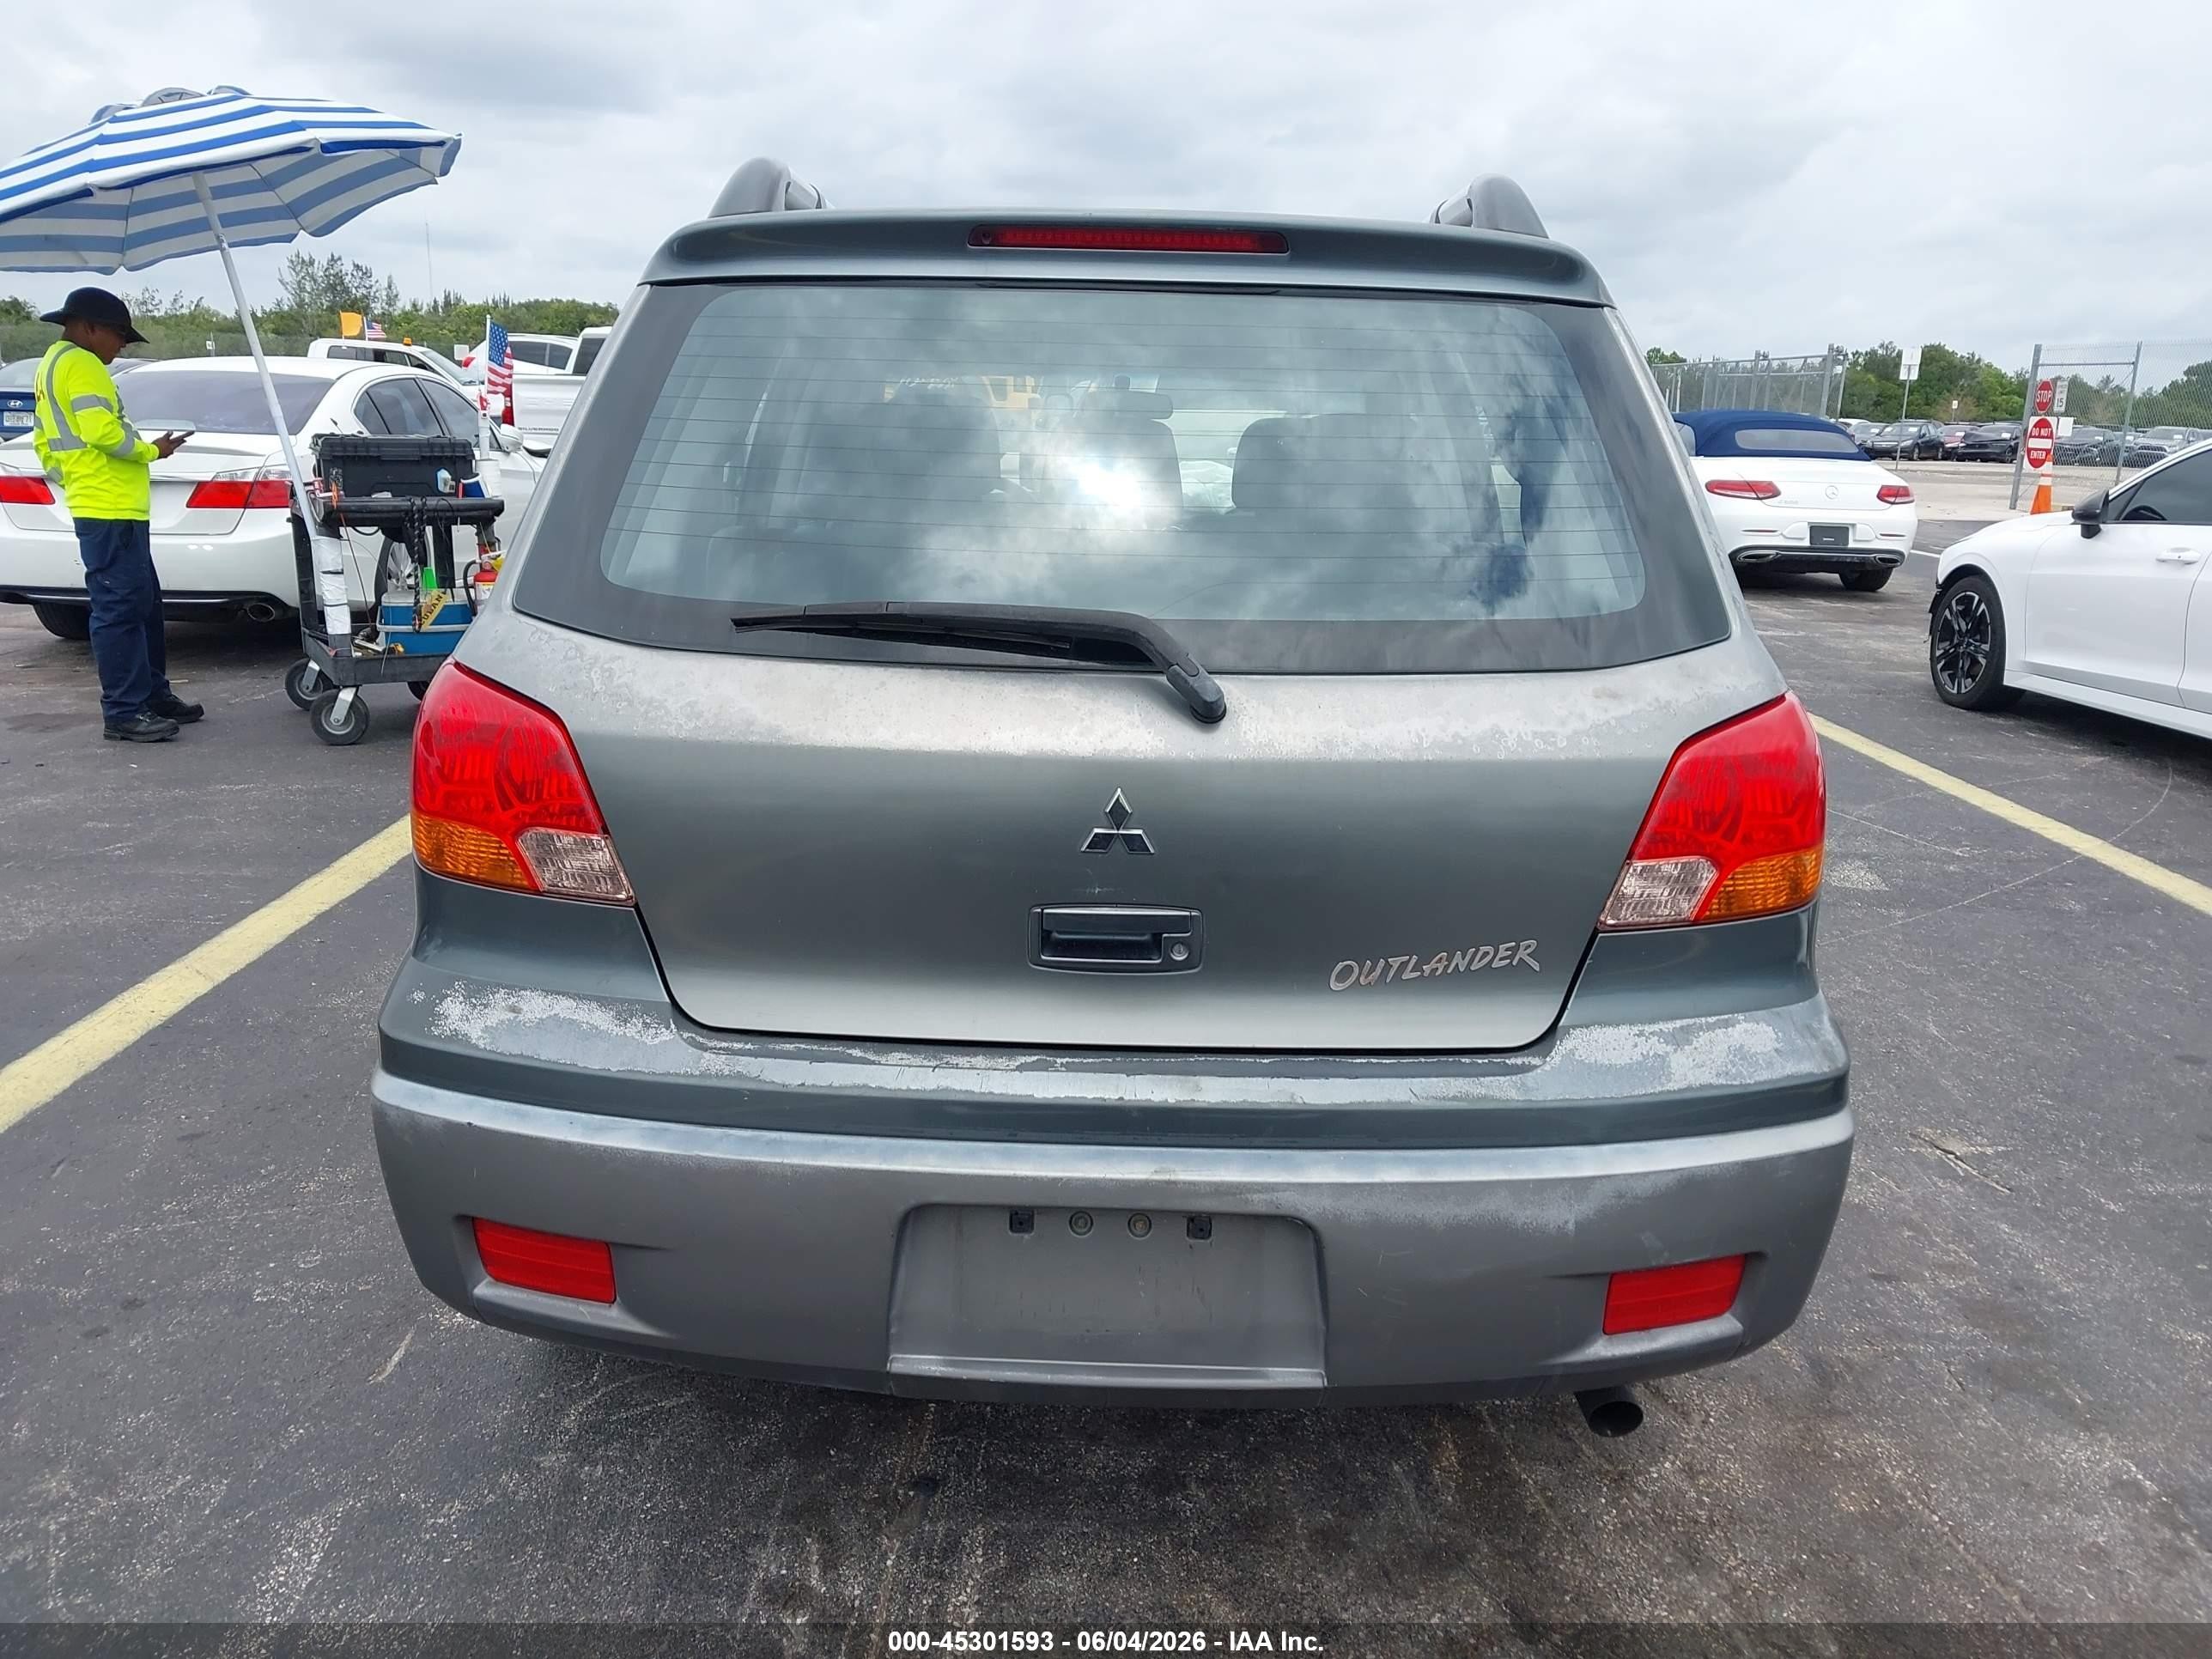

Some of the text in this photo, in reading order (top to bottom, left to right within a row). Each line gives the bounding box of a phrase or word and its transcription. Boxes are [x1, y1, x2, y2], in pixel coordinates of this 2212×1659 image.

[2036, 390, 2052, 403] STOP
[2057, 398, 2064, 408] 15
[2032, 428, 2052, 437] DO NOT
[2030, 450, 2047, 459] ENTER
[1329, 939, 1540, 991] OUTLANDER
